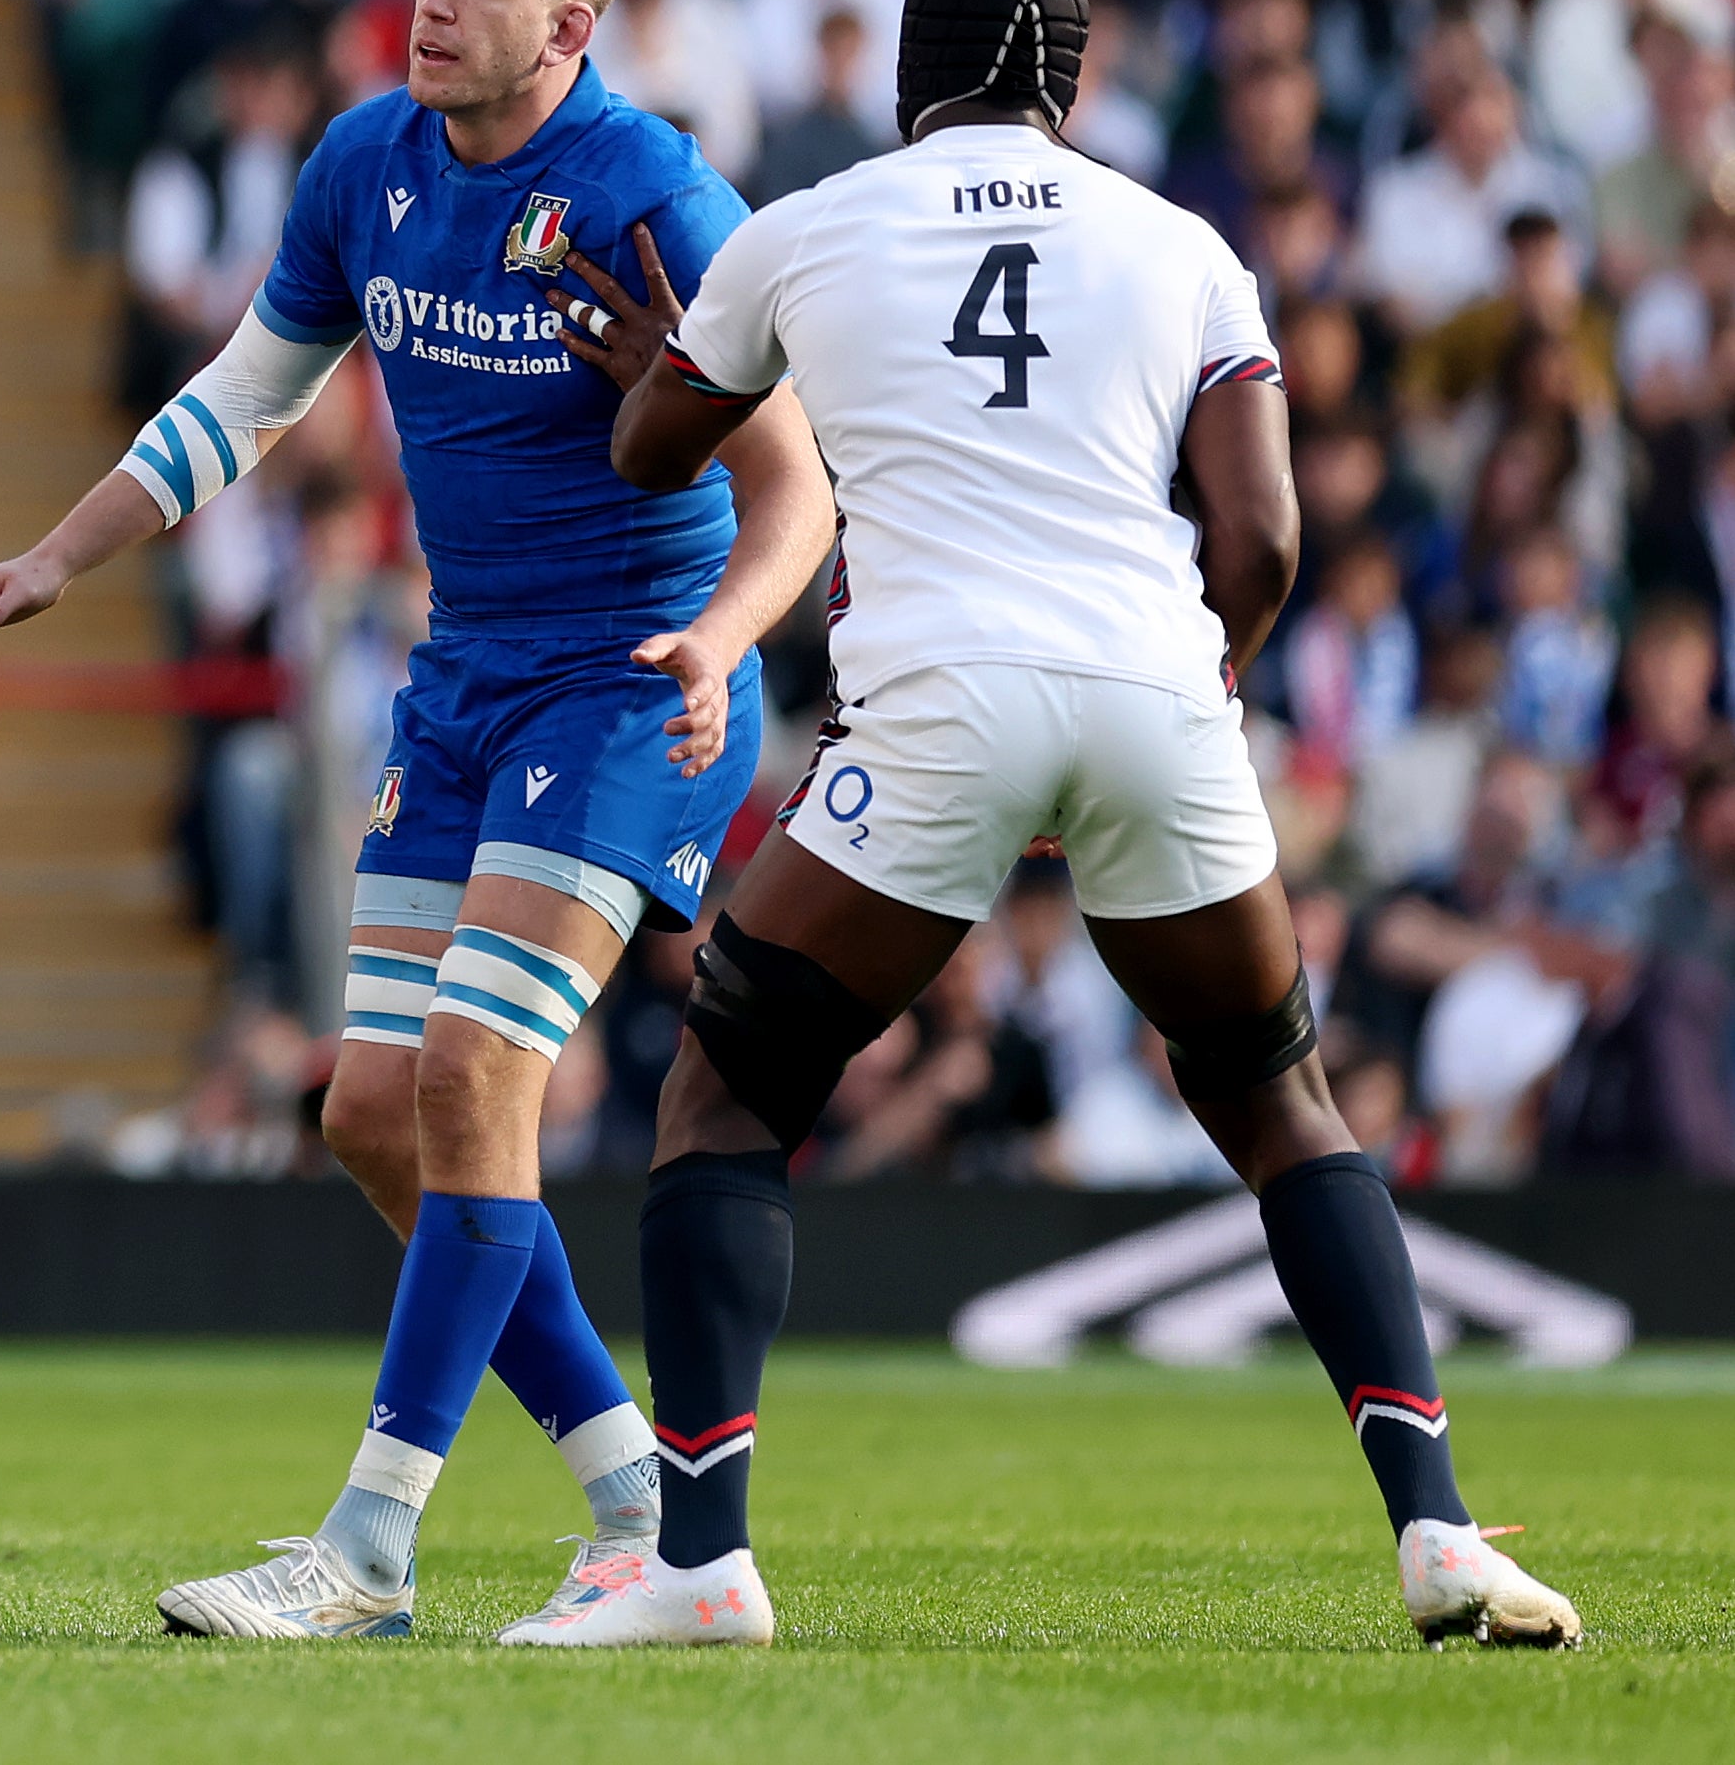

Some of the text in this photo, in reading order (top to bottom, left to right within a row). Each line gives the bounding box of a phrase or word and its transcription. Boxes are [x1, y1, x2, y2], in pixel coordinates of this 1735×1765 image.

[534, 198, 562, 212] F.I.R.
[953, 180, 1063, 213] ITOJE
[403, 288, 564, 342] Vittoria
[941, 242, 1052, 409] 4
[411, 336, 572, 375] Assicurazioni
